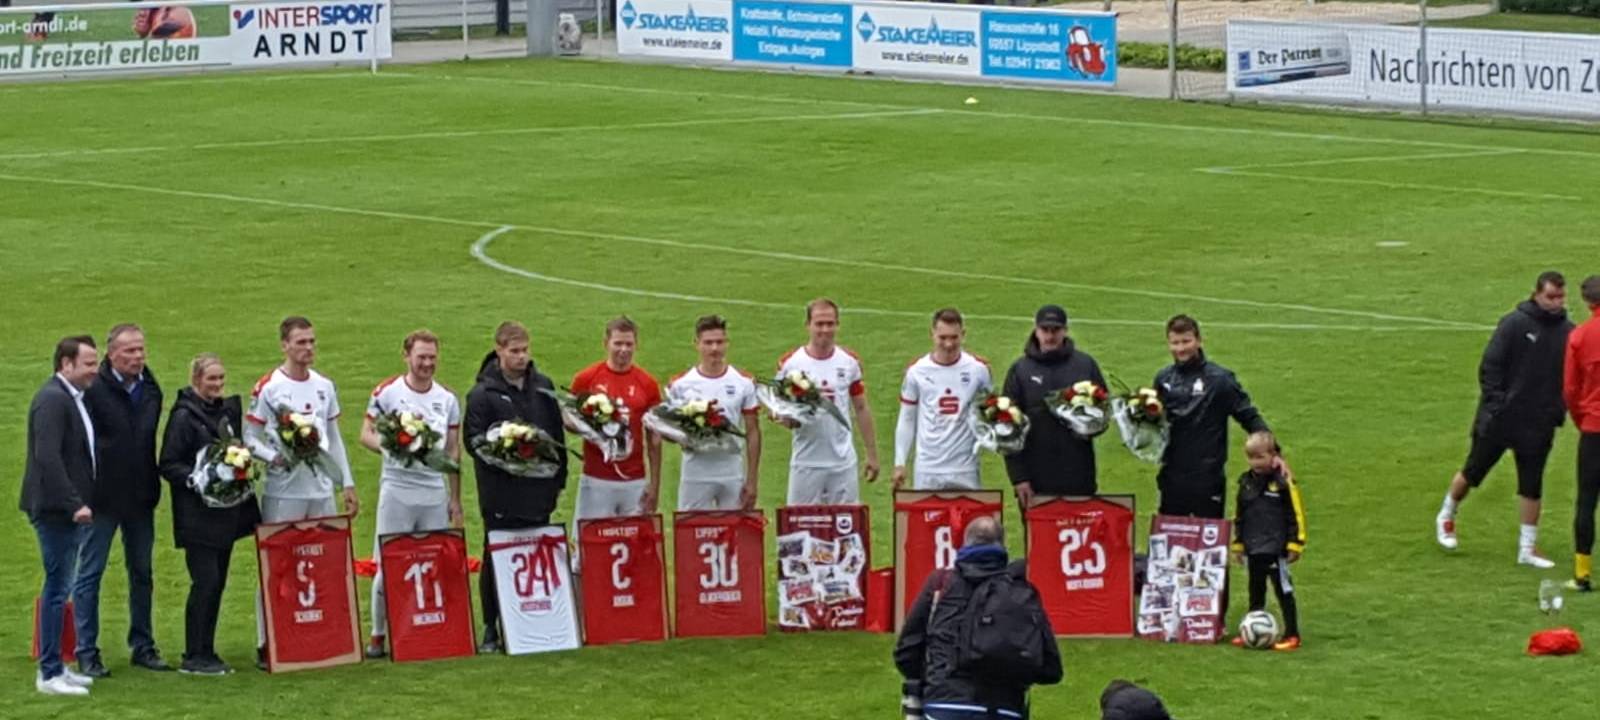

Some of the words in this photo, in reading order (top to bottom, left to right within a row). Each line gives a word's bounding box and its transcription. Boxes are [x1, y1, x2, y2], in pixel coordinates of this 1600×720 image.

[258, 4, 384, 28] INTERSPORT
[636, 4, 729, 33] STAKEMEIER
[254, 30, 367, 58] ARNDT
[874, 15, 977, 48] STAKEMEIER
[30, 41, 113, 68] Freizeit
[119, 40, 199, 64] erleben
[1258, 50, 1278, 65] Der
[1525, 64, 1570, 92] von
[610, 542, 632, 590] 2
[699, 541, 738, 588] 30
